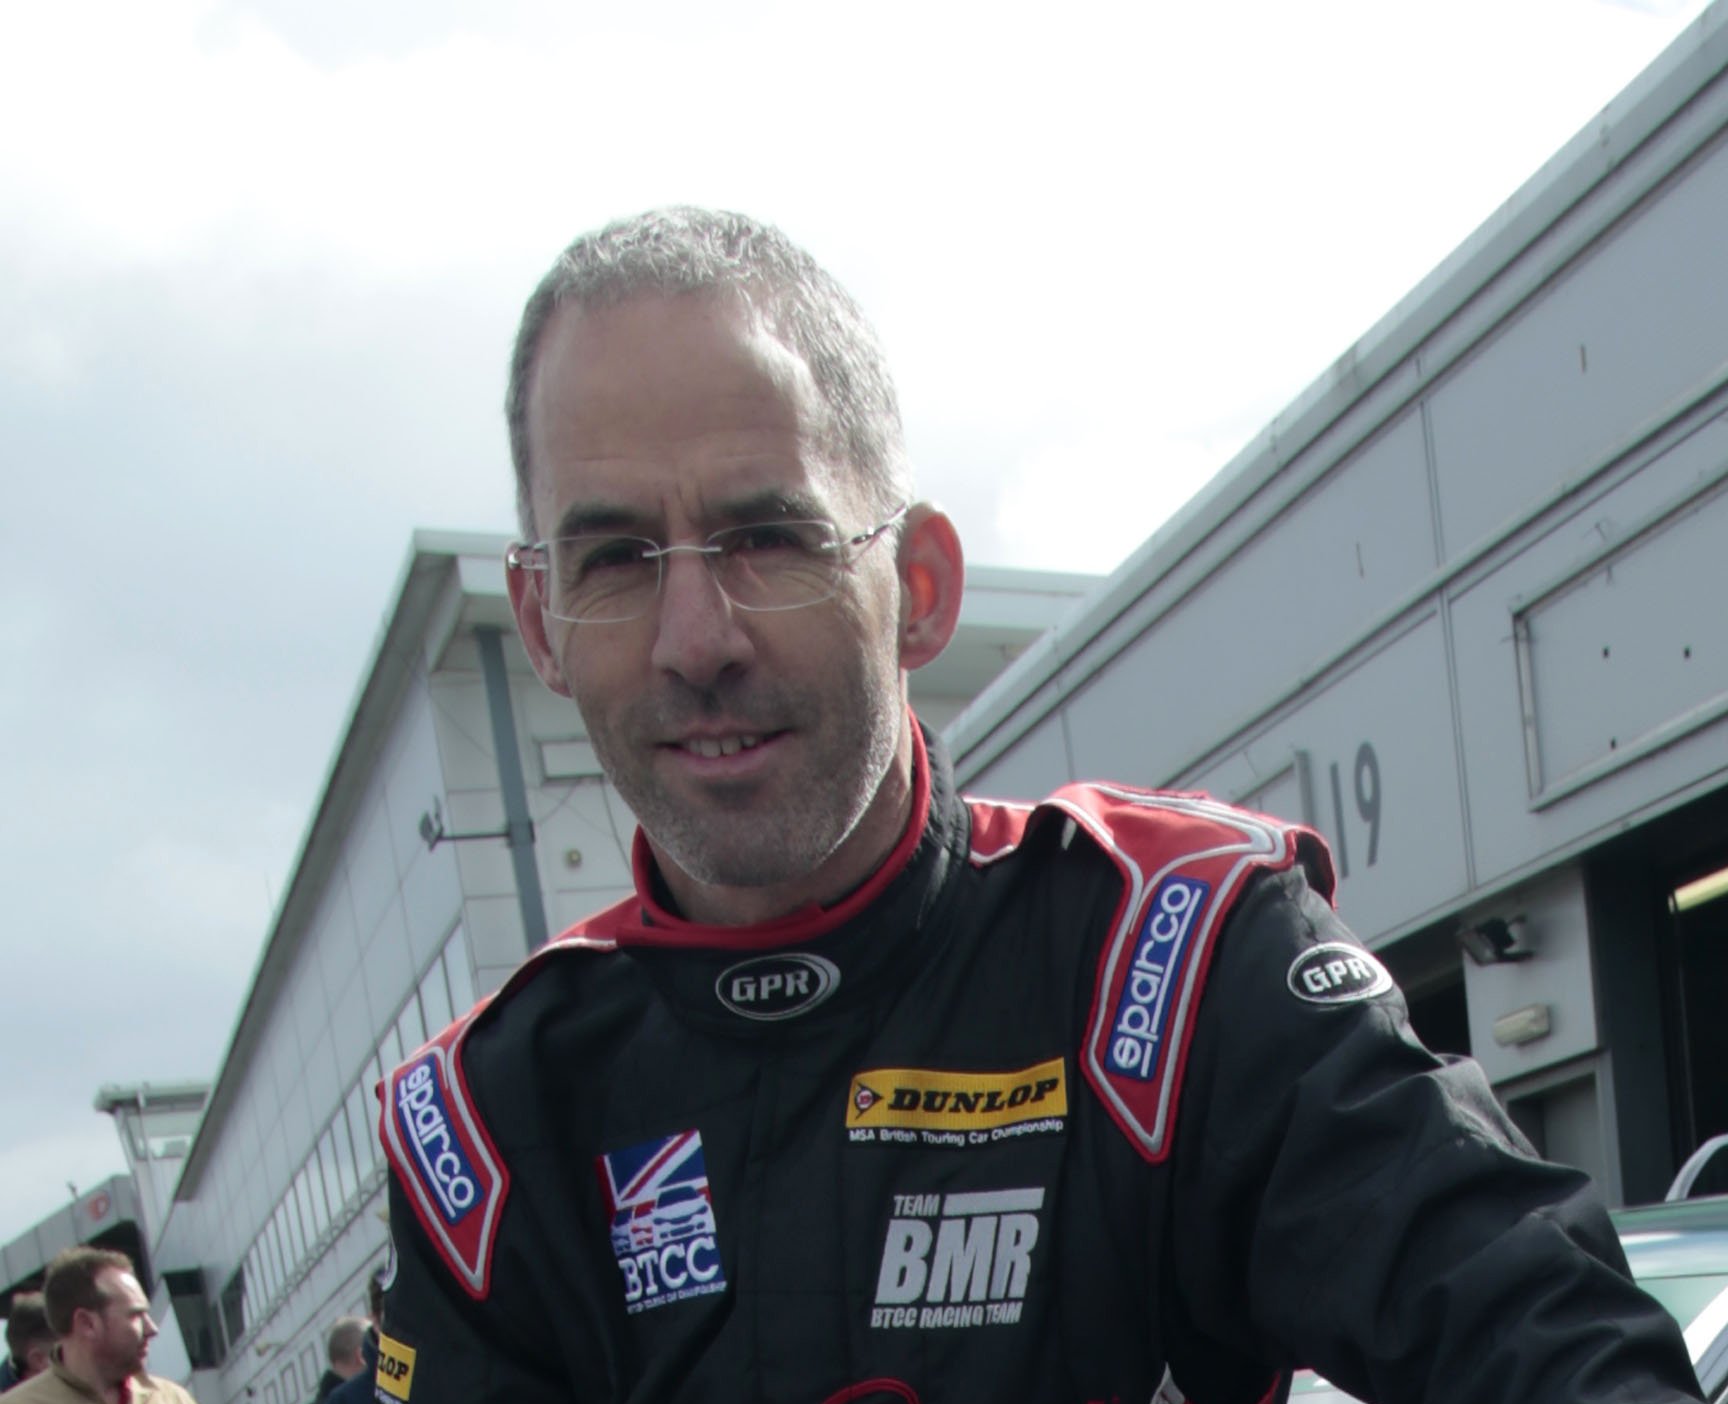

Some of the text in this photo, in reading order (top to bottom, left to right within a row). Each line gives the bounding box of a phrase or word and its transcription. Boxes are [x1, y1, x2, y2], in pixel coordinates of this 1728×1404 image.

[1329, 740, 1381, 880] 19
[732, 969, 809, 1002] GPR
[1113, 883, 1197, 1073] sparco
[1302, 957, 1372, 994] GPR
[888, 1078, 1059, 1113] DUNLOP
[399, 1064, 475, 1211] sparco
[850, 1119, 1064, 1147] MSA British Touring Car Championship
[893, 1194, 940, 1216] TEAM
[618, 1236, 719, 1302] BTCC
[875, 1213, 1039, 1304] BMR
[870, 1302, 1024, 1328] BTCC RACING TEAM
